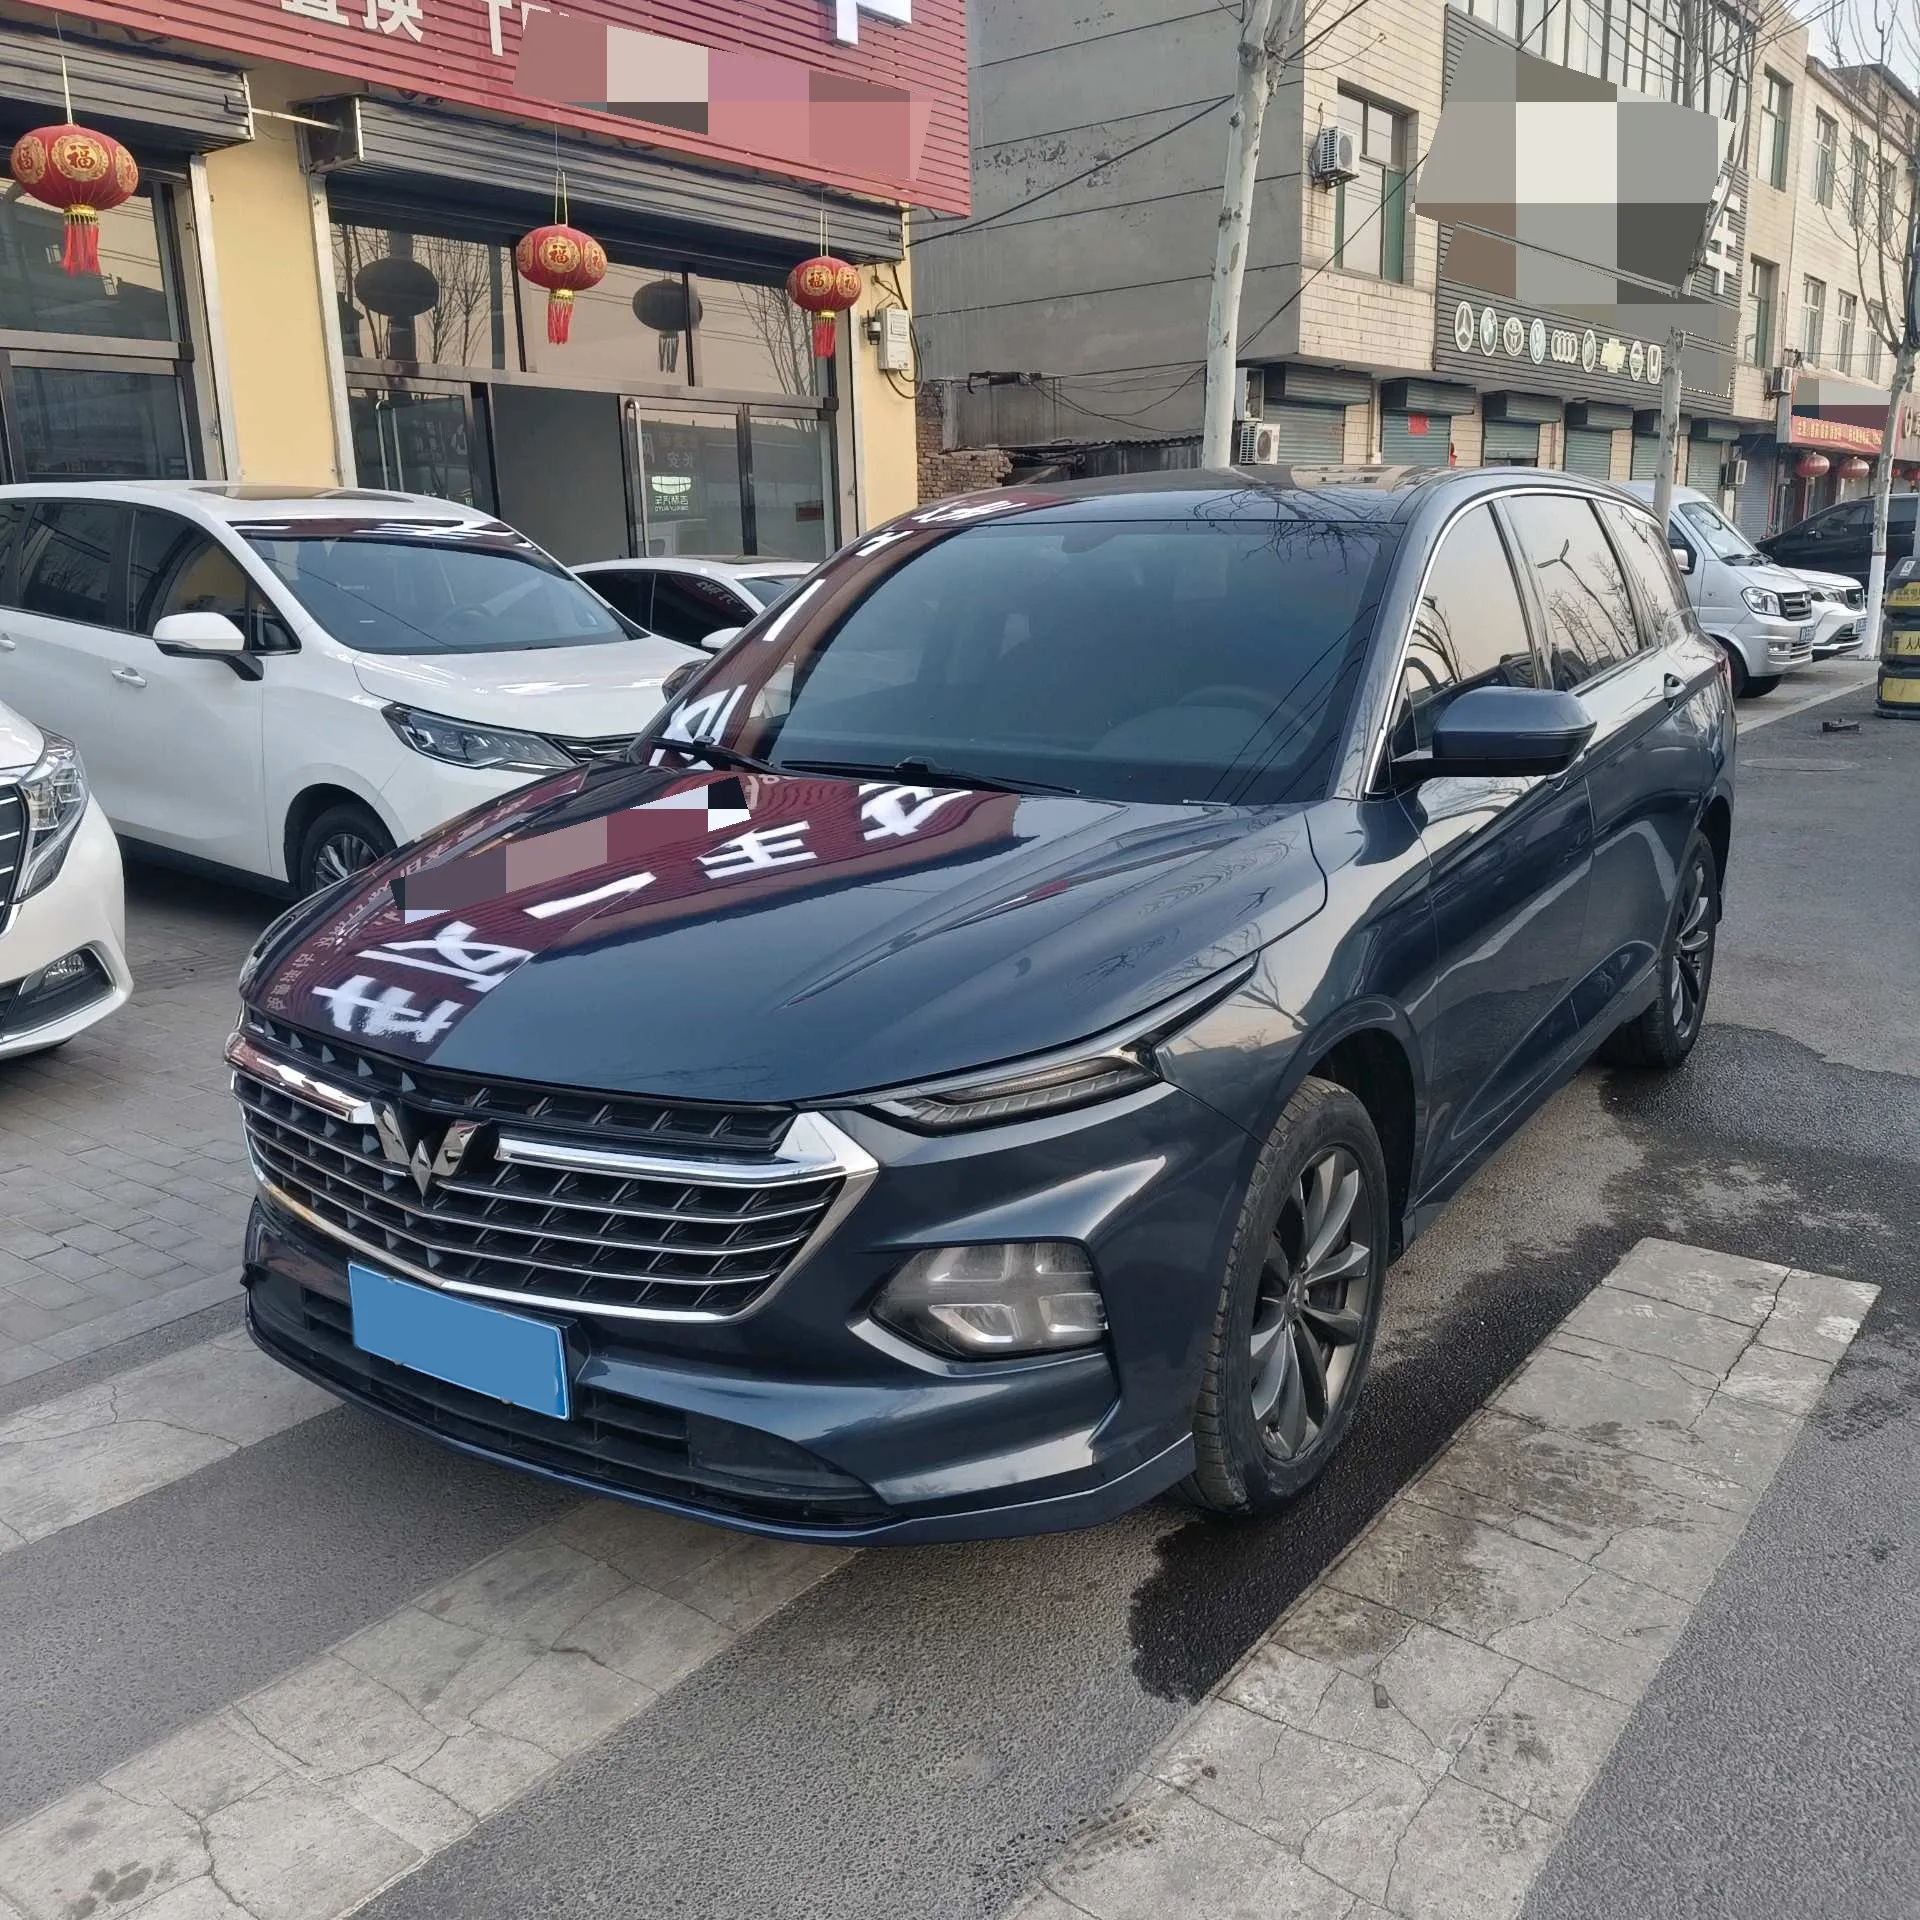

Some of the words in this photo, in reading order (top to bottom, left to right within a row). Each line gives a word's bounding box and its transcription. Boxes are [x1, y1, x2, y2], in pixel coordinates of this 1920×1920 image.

[66, 144, 95, 169] 福
[549, 244, 569, 264] 福
[808, 272, 825, 289] 福
